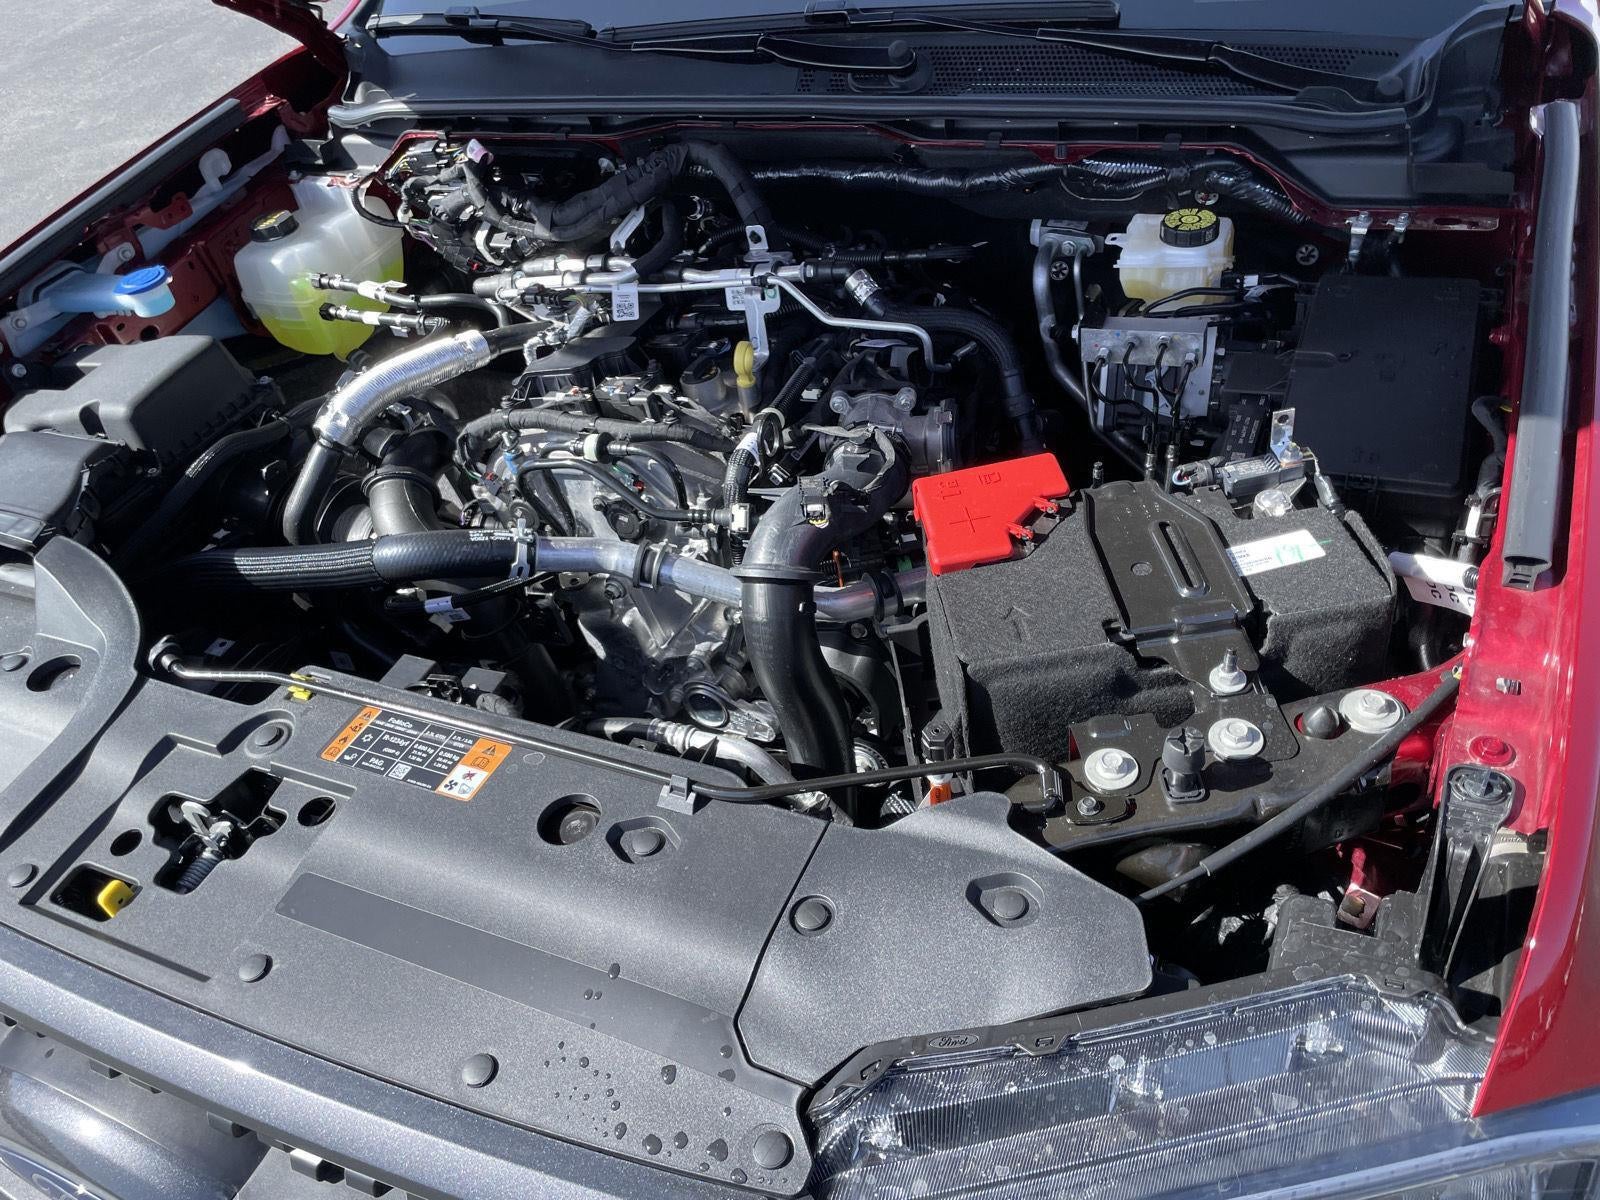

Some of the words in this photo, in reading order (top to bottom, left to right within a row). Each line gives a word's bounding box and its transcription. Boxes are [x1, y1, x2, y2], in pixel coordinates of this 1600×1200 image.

[388, 717, 413, 728] FoMoCo
[382, 734, 411, 747] R-1234yf
[369, 757, 384, 766] PAG
[938, 1035, 969, 1047] Ford
